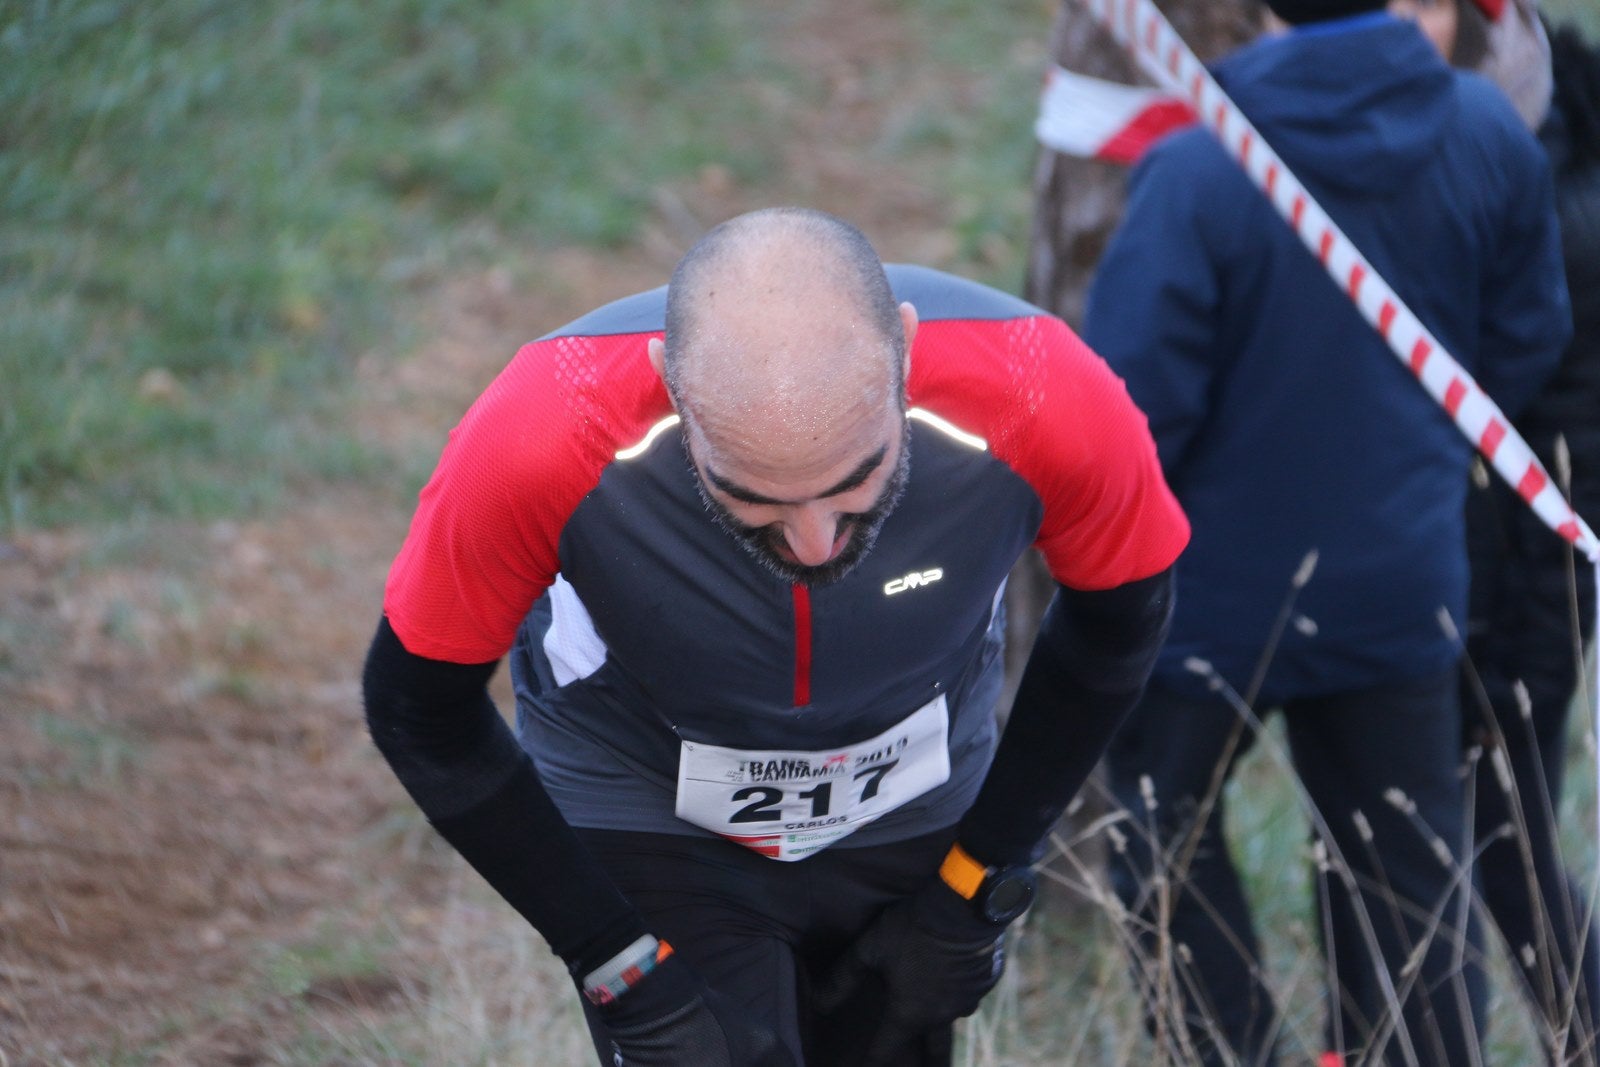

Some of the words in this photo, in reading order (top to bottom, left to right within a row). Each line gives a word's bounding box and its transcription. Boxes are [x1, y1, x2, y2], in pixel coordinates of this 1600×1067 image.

[884, 567, 944, 596] CMP
[738, 759, 810, 778] TRANS
[728, 757, 900, 824] 217
[784, 815, 849, 830] CARLOS
